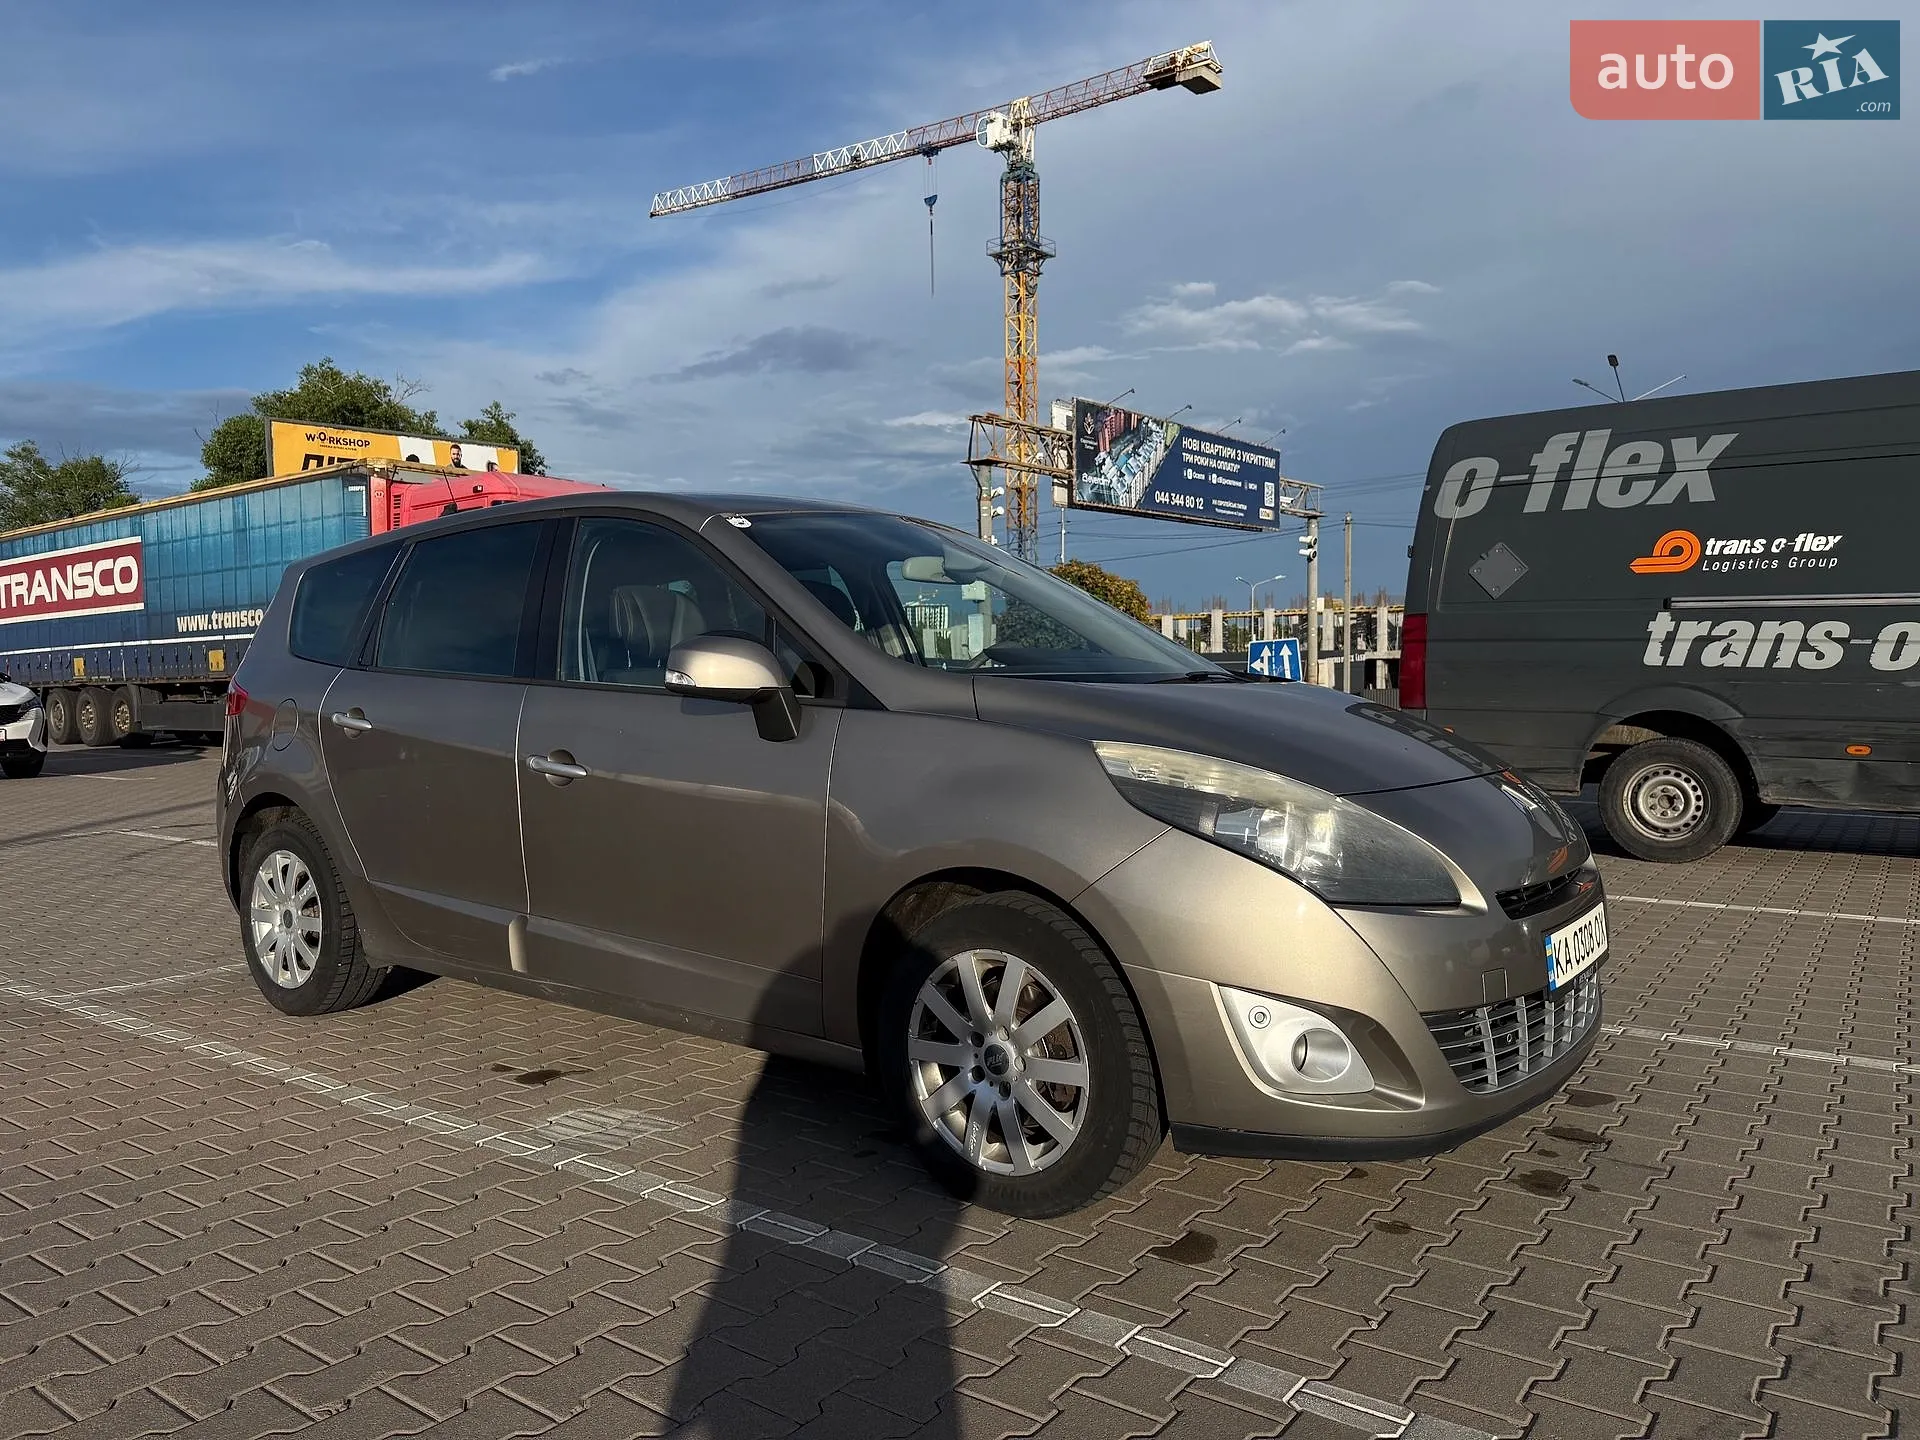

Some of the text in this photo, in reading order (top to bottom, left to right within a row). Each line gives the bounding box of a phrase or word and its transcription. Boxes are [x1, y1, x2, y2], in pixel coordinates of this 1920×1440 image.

[1182, 437, 1199, 451] НОВІ
[1200, 441, 1236, 459] КВАРТИРИ
[1433, 428, 1739, 519] o-flex
[1155, 490, 1170, 504] 044
[1170, 492, 1184, 507] 344
[1185, 495, 1195, 508] 80
[1195, 497, 1204, 510] 12
[1705, 533, 1843, 556] trans o-flex
[1703, 556, 1838, 573] Logistics Group
